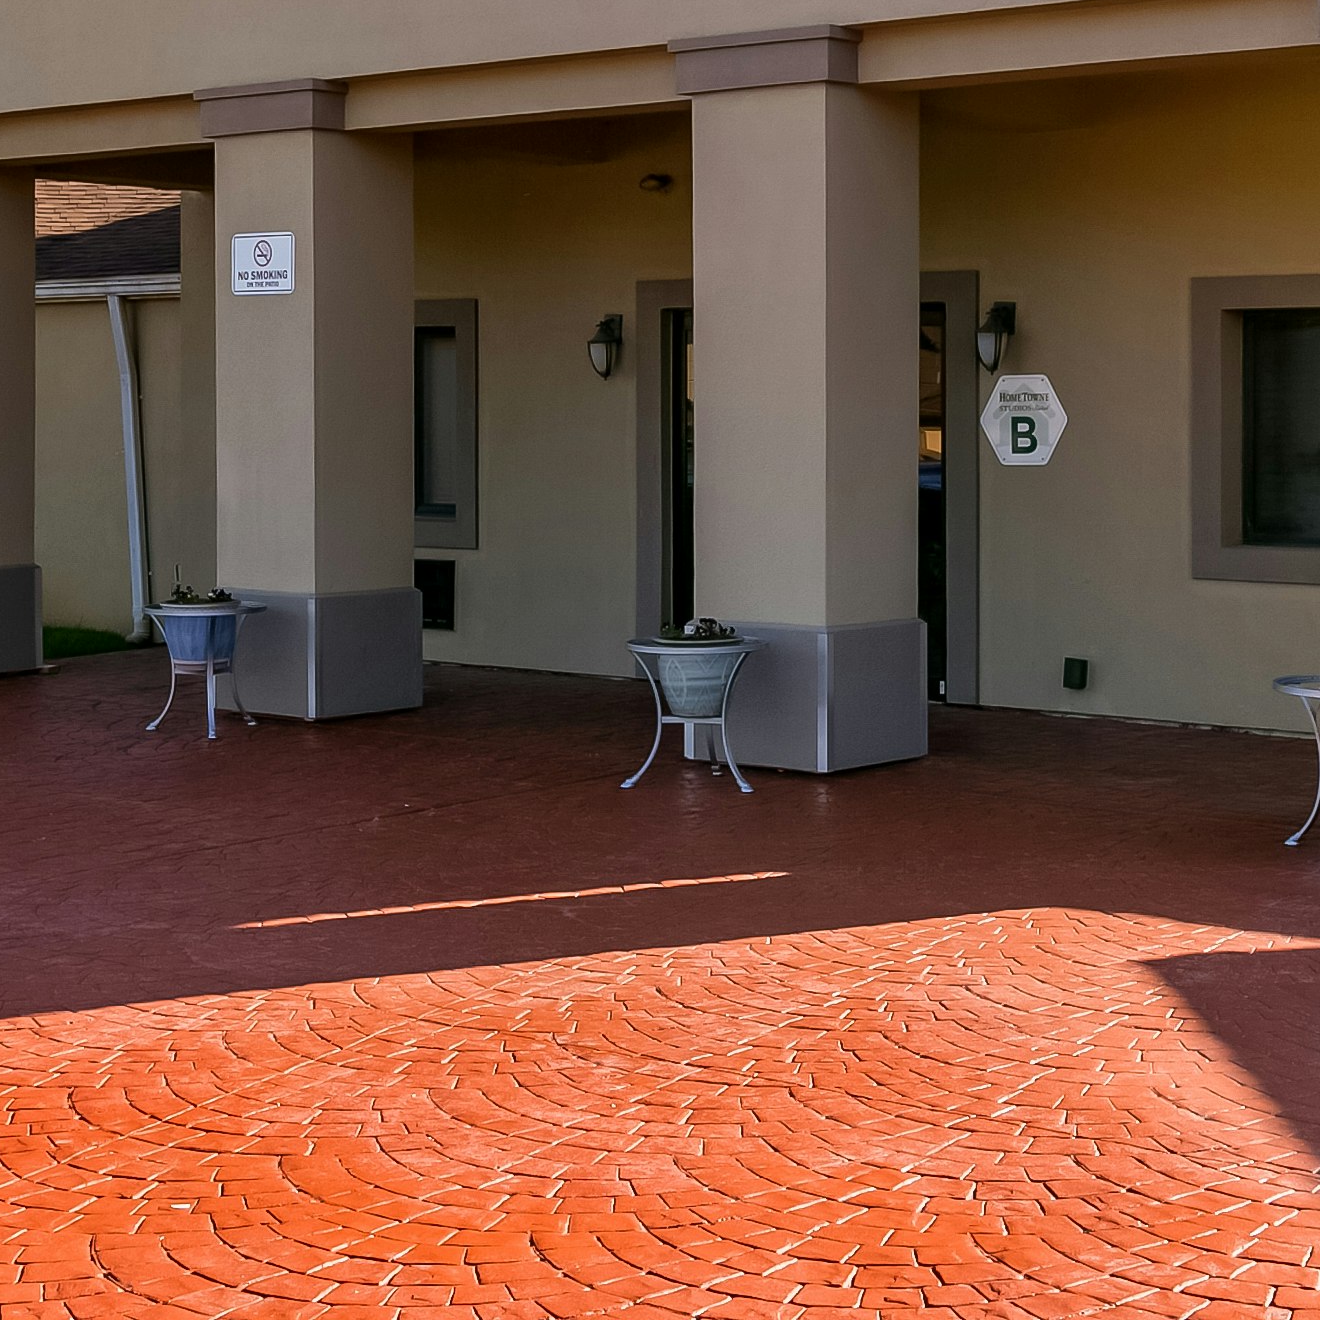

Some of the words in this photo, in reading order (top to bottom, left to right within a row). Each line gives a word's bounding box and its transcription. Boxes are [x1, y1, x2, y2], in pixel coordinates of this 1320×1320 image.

[237, 271, 249, 281] NO
[250, 269, 288, 280] SMOKING
[1011, 416, 1038, 455] B
